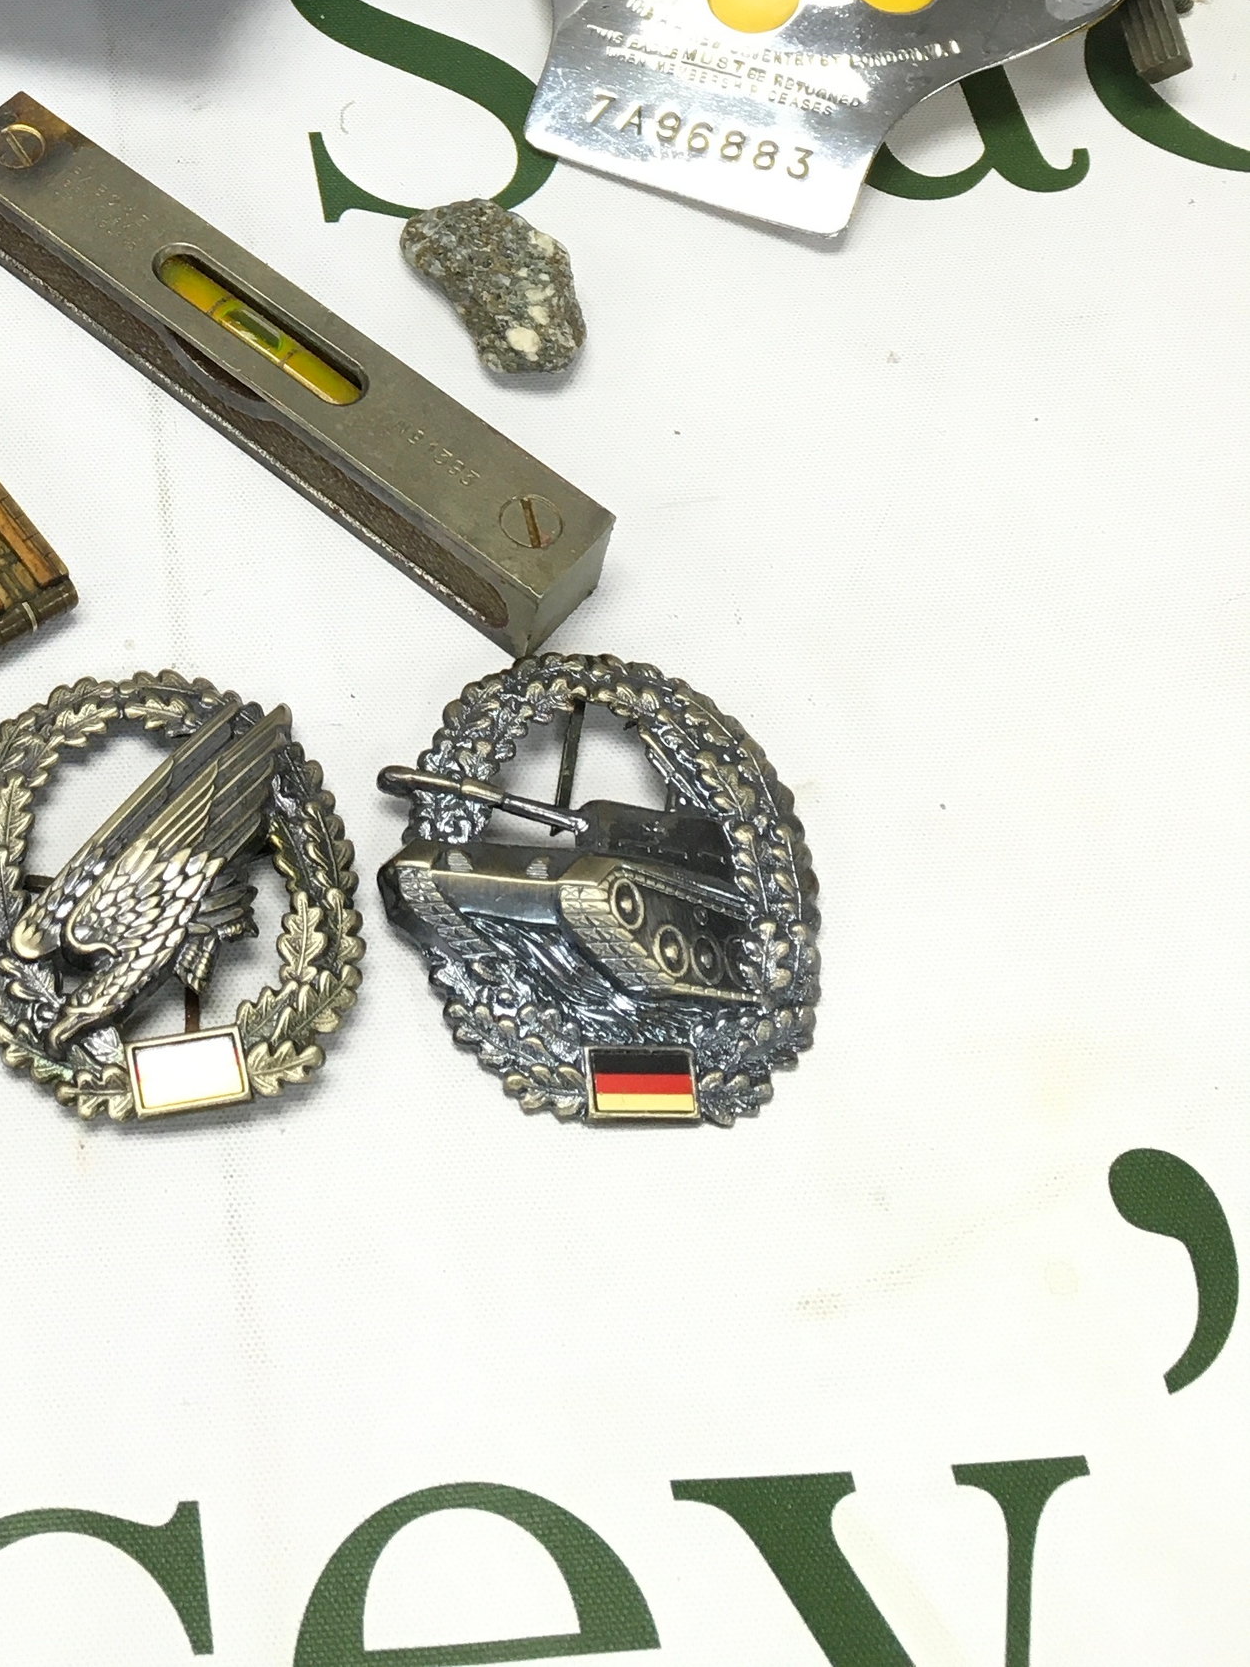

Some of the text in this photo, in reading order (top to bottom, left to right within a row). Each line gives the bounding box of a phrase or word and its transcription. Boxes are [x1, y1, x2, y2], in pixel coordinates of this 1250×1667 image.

[681, 48, 747, 77] MUST
[767, 89, 834, 117] CEASES
[588, 92, 815, 181] 7A96883
